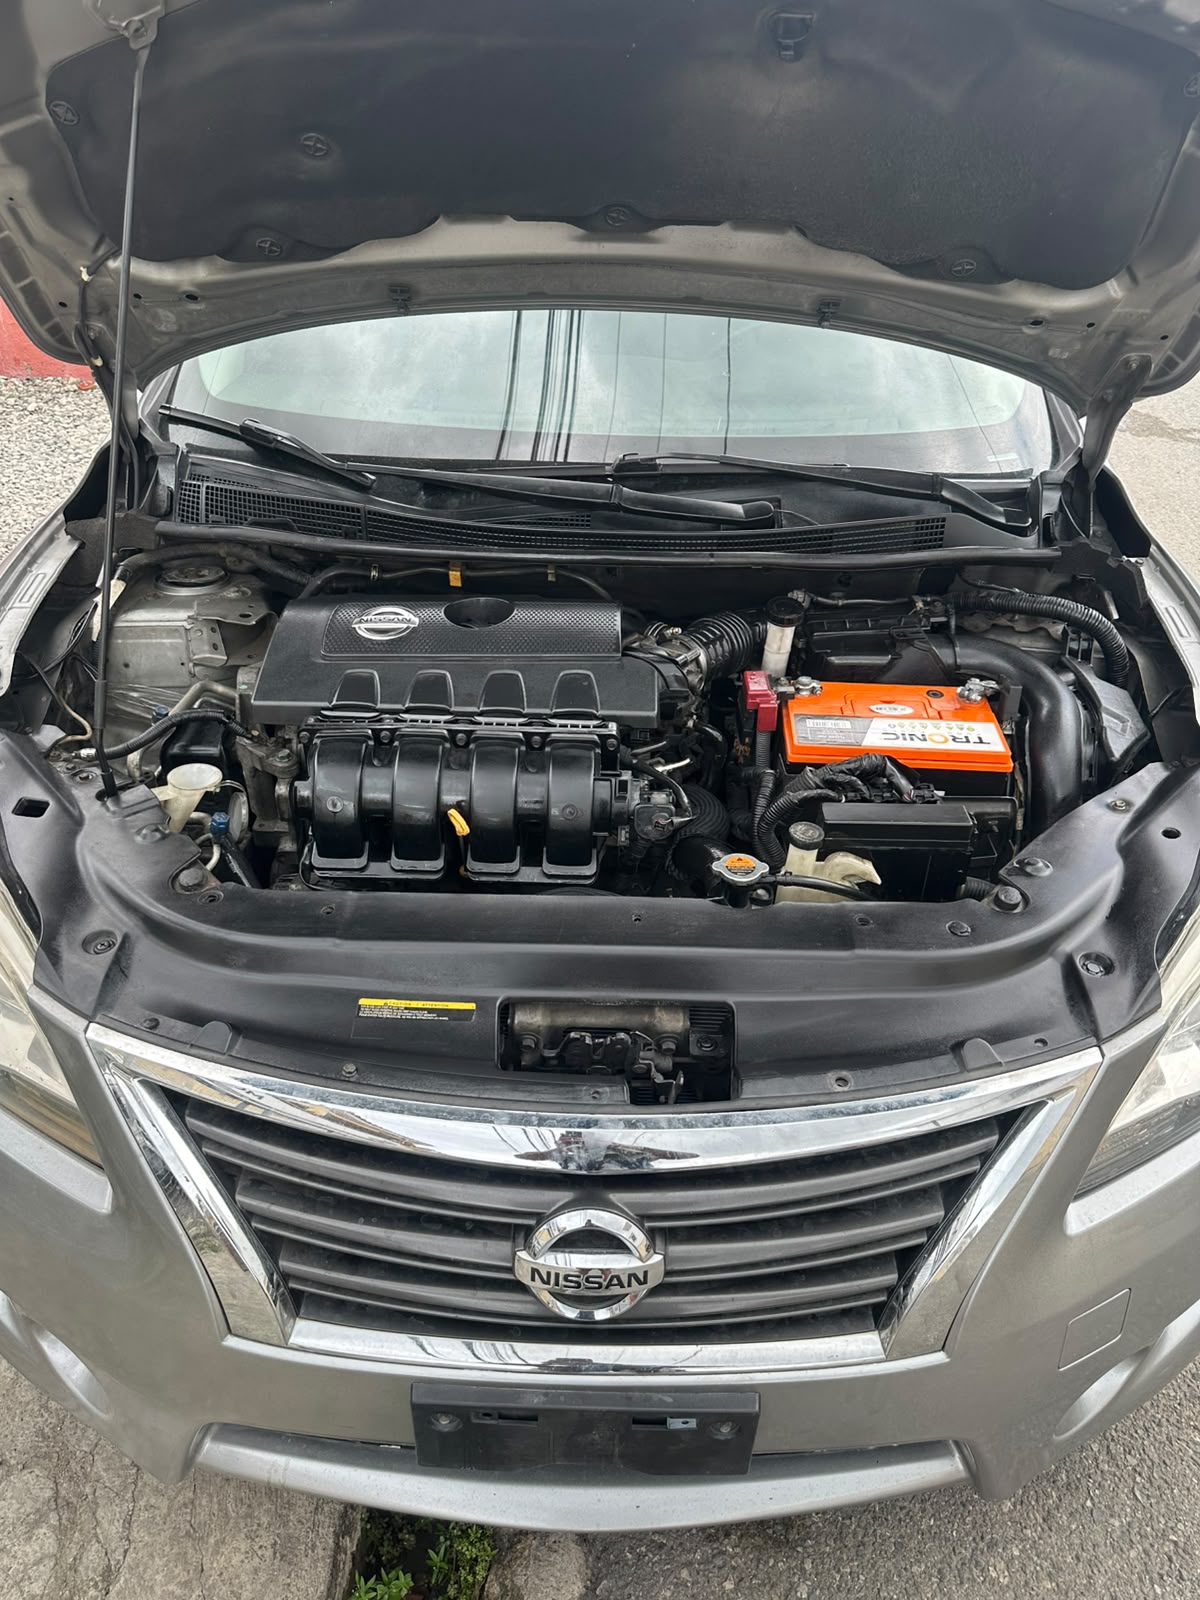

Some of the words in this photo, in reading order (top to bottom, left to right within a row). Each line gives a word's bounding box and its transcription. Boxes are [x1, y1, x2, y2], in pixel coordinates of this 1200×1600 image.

[360, 616, 411, 624] NISSAN
[883, 732, 991, 745] TRONIC
[530, 1266, 648, 1290] NISSAN
